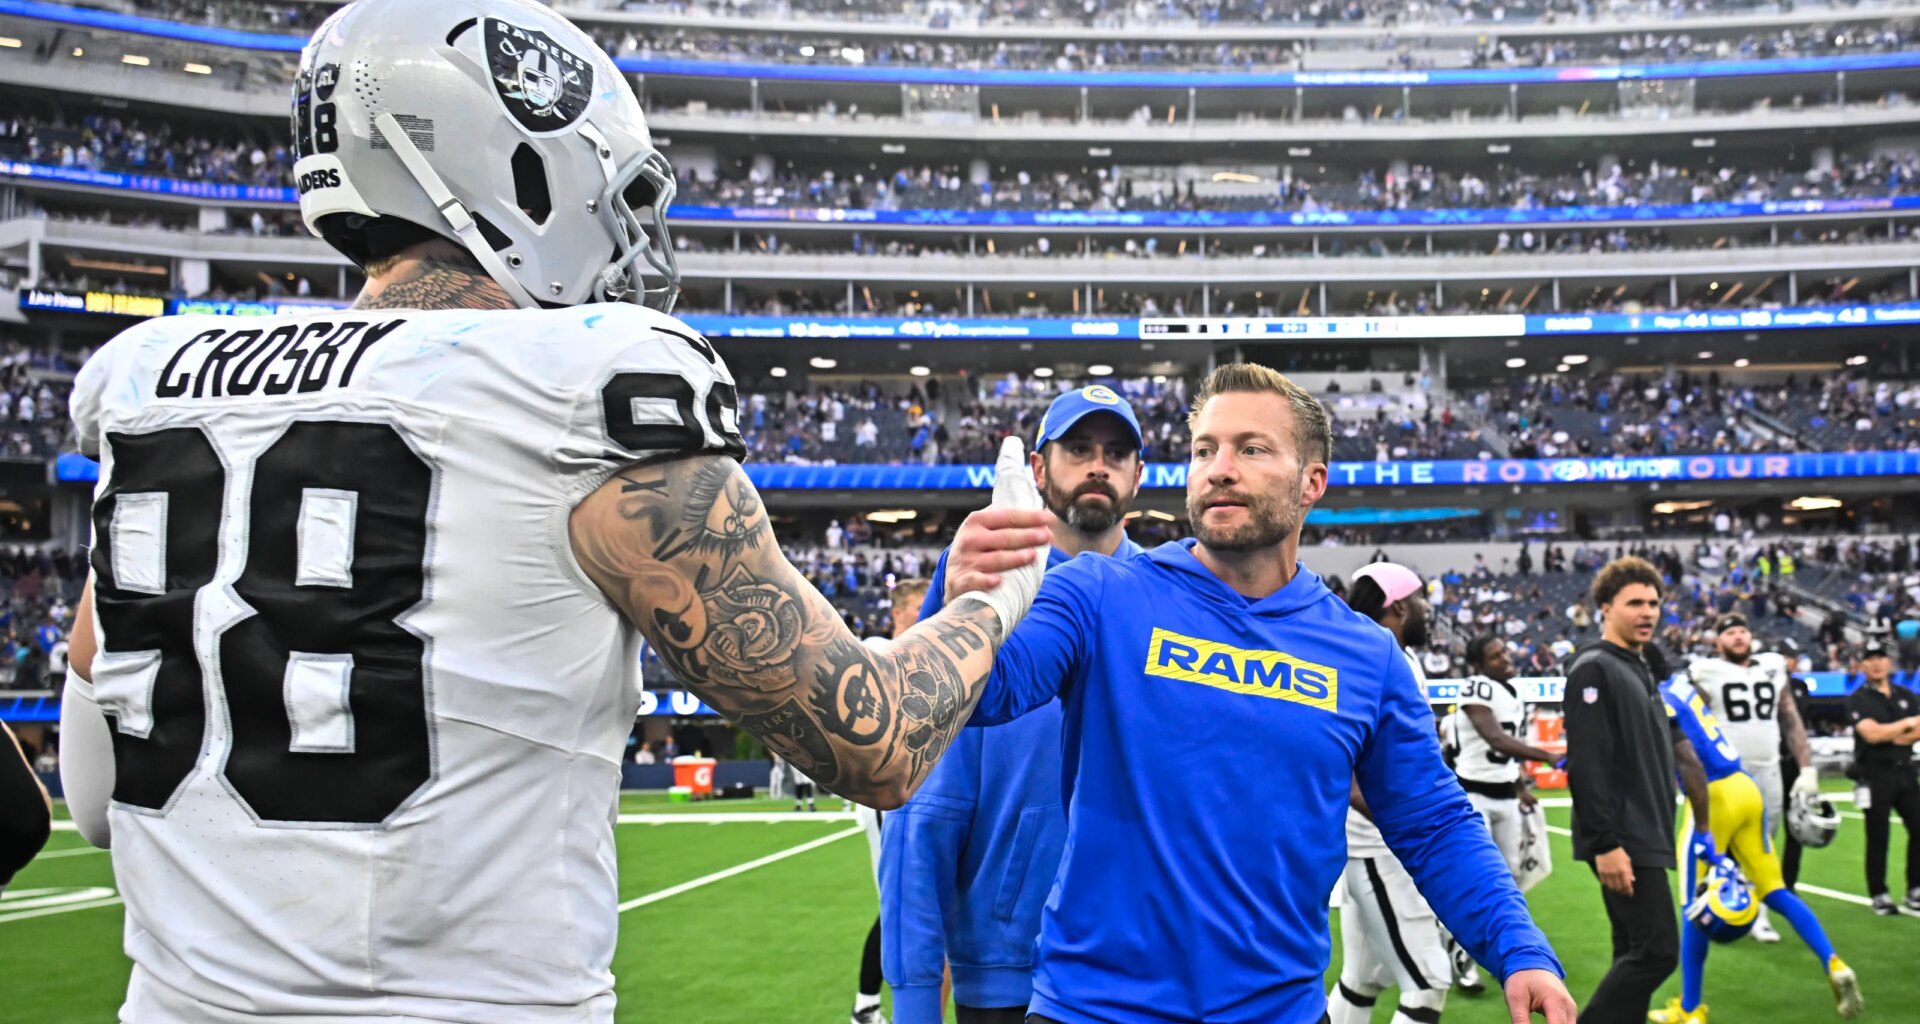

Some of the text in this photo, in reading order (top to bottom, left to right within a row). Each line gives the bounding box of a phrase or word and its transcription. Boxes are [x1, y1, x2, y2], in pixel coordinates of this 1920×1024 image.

[496, 21, 585, 71] RAIDERS
[155, 318, 408, 399] CROSBY
[1338, 462, 1435, 484] THE
[90, 417, 440, 826] 98
[1157, 638, 1329, 700] RAMS
[1461, 680, 1493, 701] 30
[1722, 681, 1776, 722] 68
